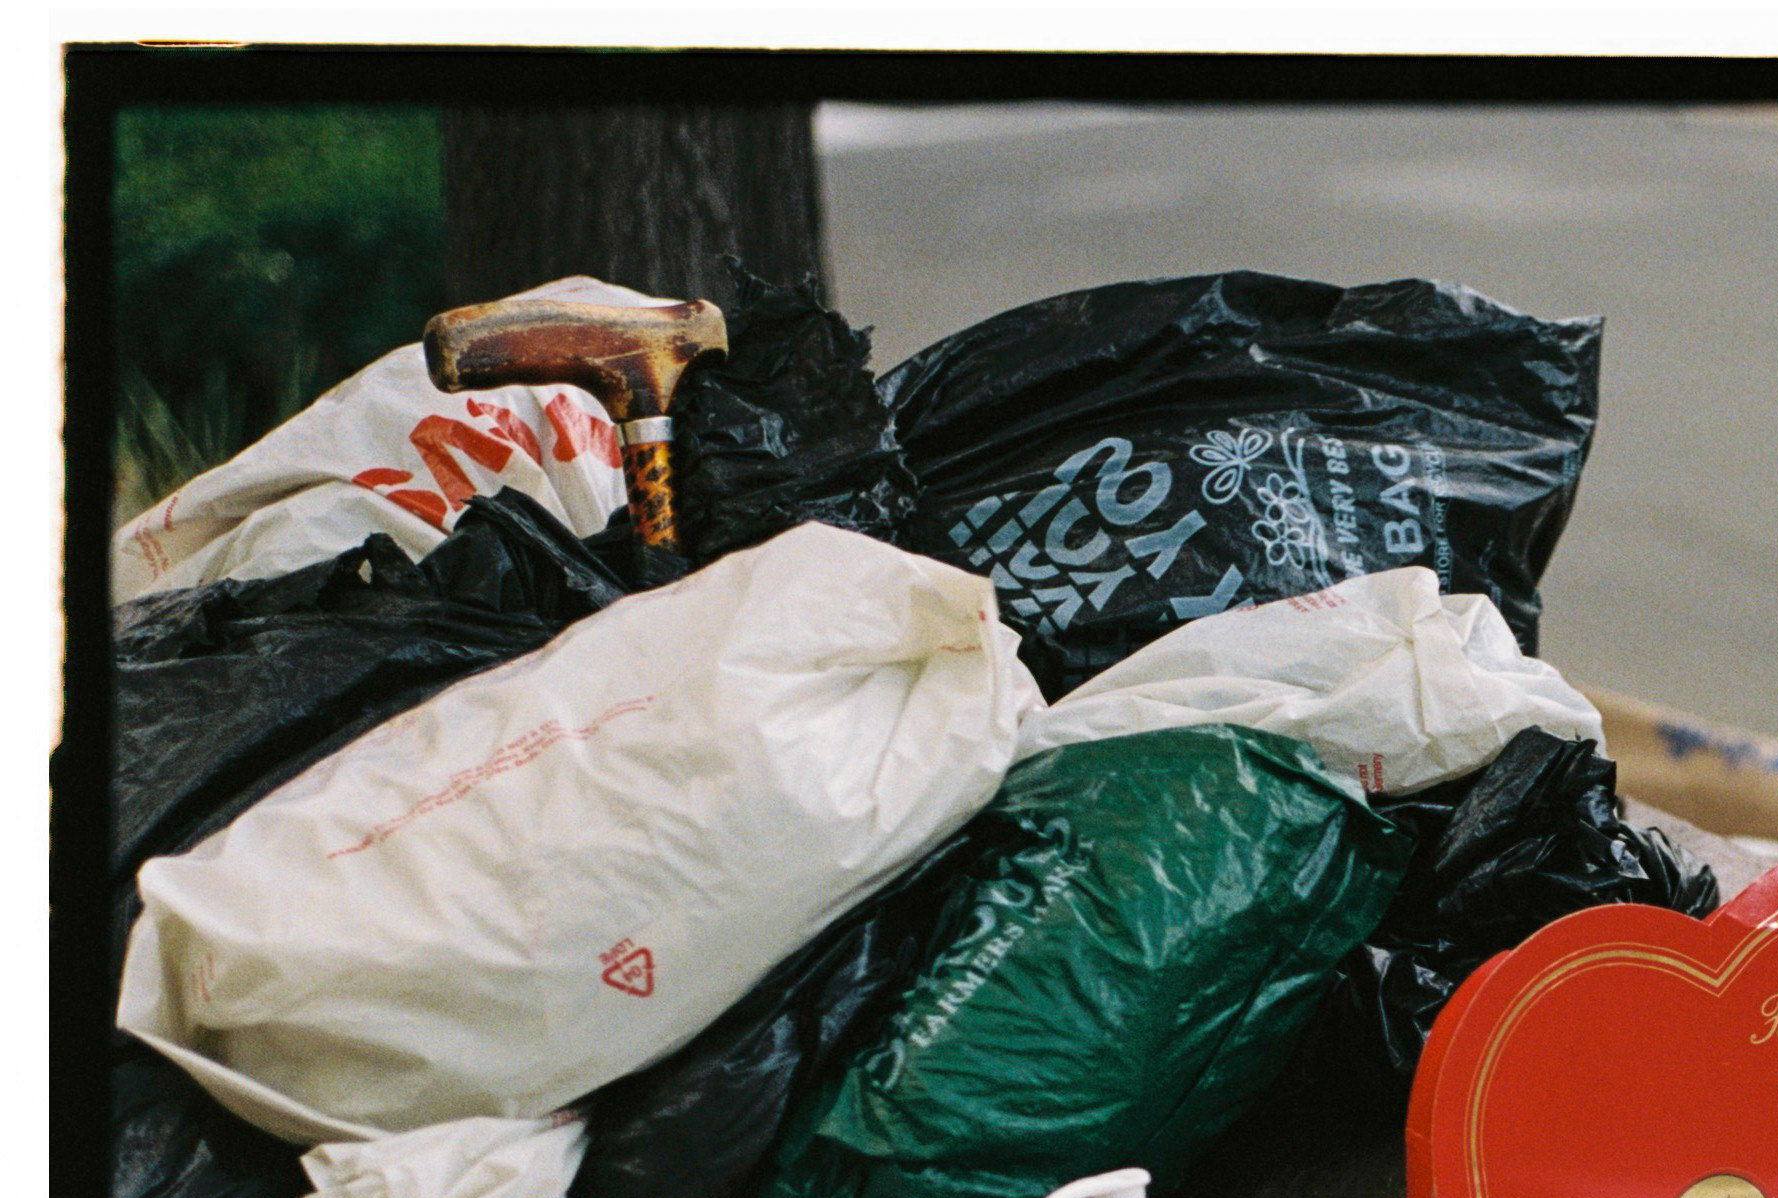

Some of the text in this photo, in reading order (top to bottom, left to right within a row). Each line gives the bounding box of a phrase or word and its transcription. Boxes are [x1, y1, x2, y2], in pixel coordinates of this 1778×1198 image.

[1330, 479, 1359, 543] VERY
[1371, 444, 1425, 553] BAG
[909, 922, 1025, 1048] FARMERS
